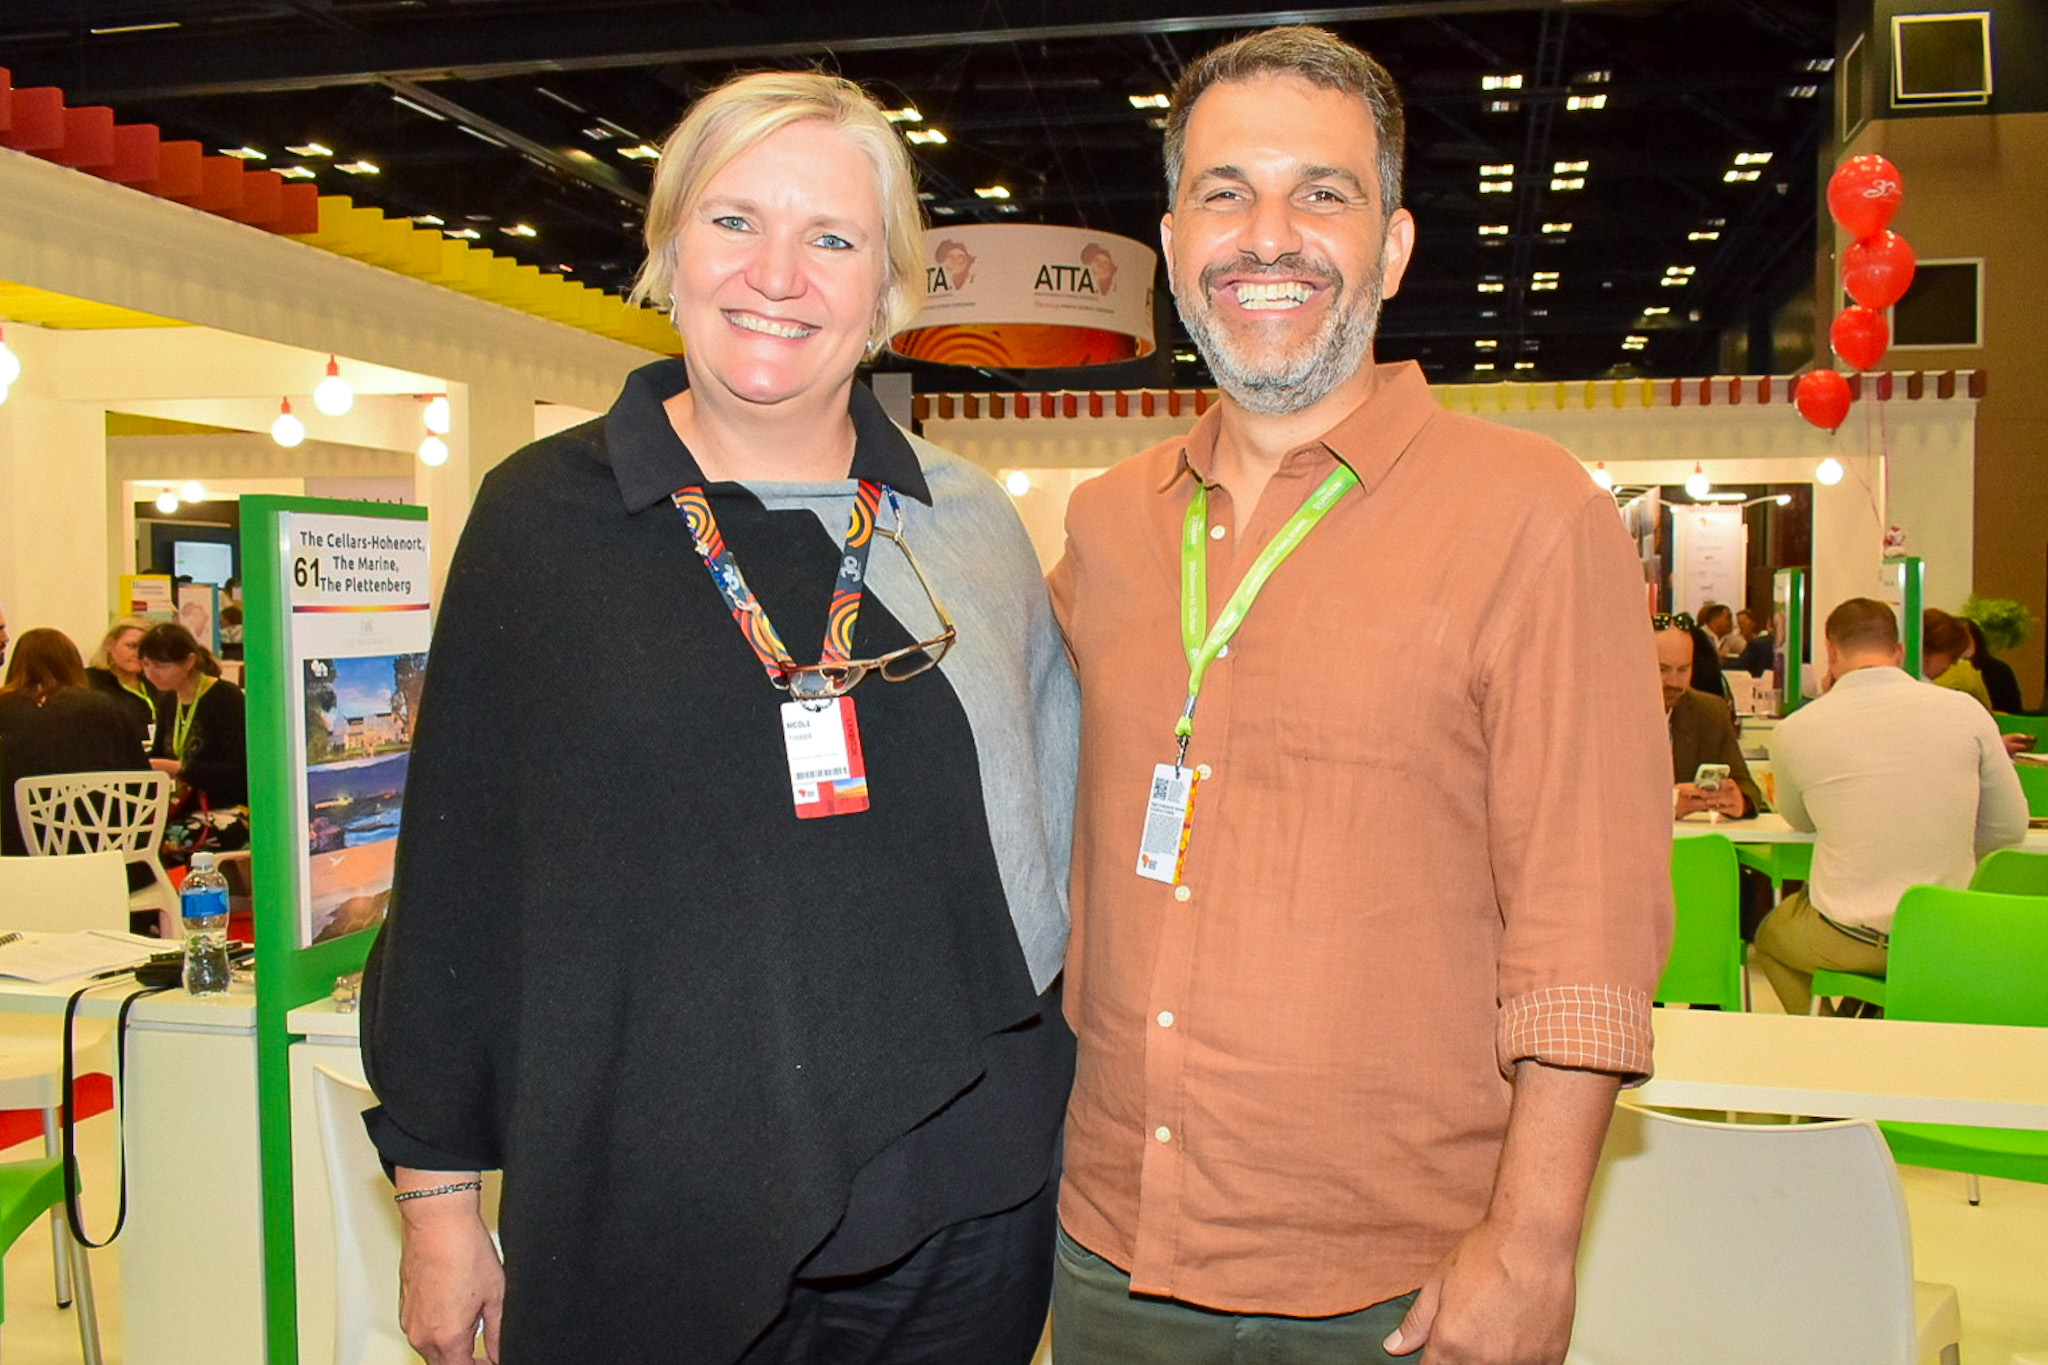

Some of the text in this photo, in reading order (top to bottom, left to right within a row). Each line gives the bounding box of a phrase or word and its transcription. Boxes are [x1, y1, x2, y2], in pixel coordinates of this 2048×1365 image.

[1034, 264, 1096, 294] ATTA
[300, 531, 426, 552] The Cellars-Hohenort,
[294, 557, 320, 588] 61
[332, 555, 400, 573] The Marine,
[320, 577, 412, 595] The Plettenberg
